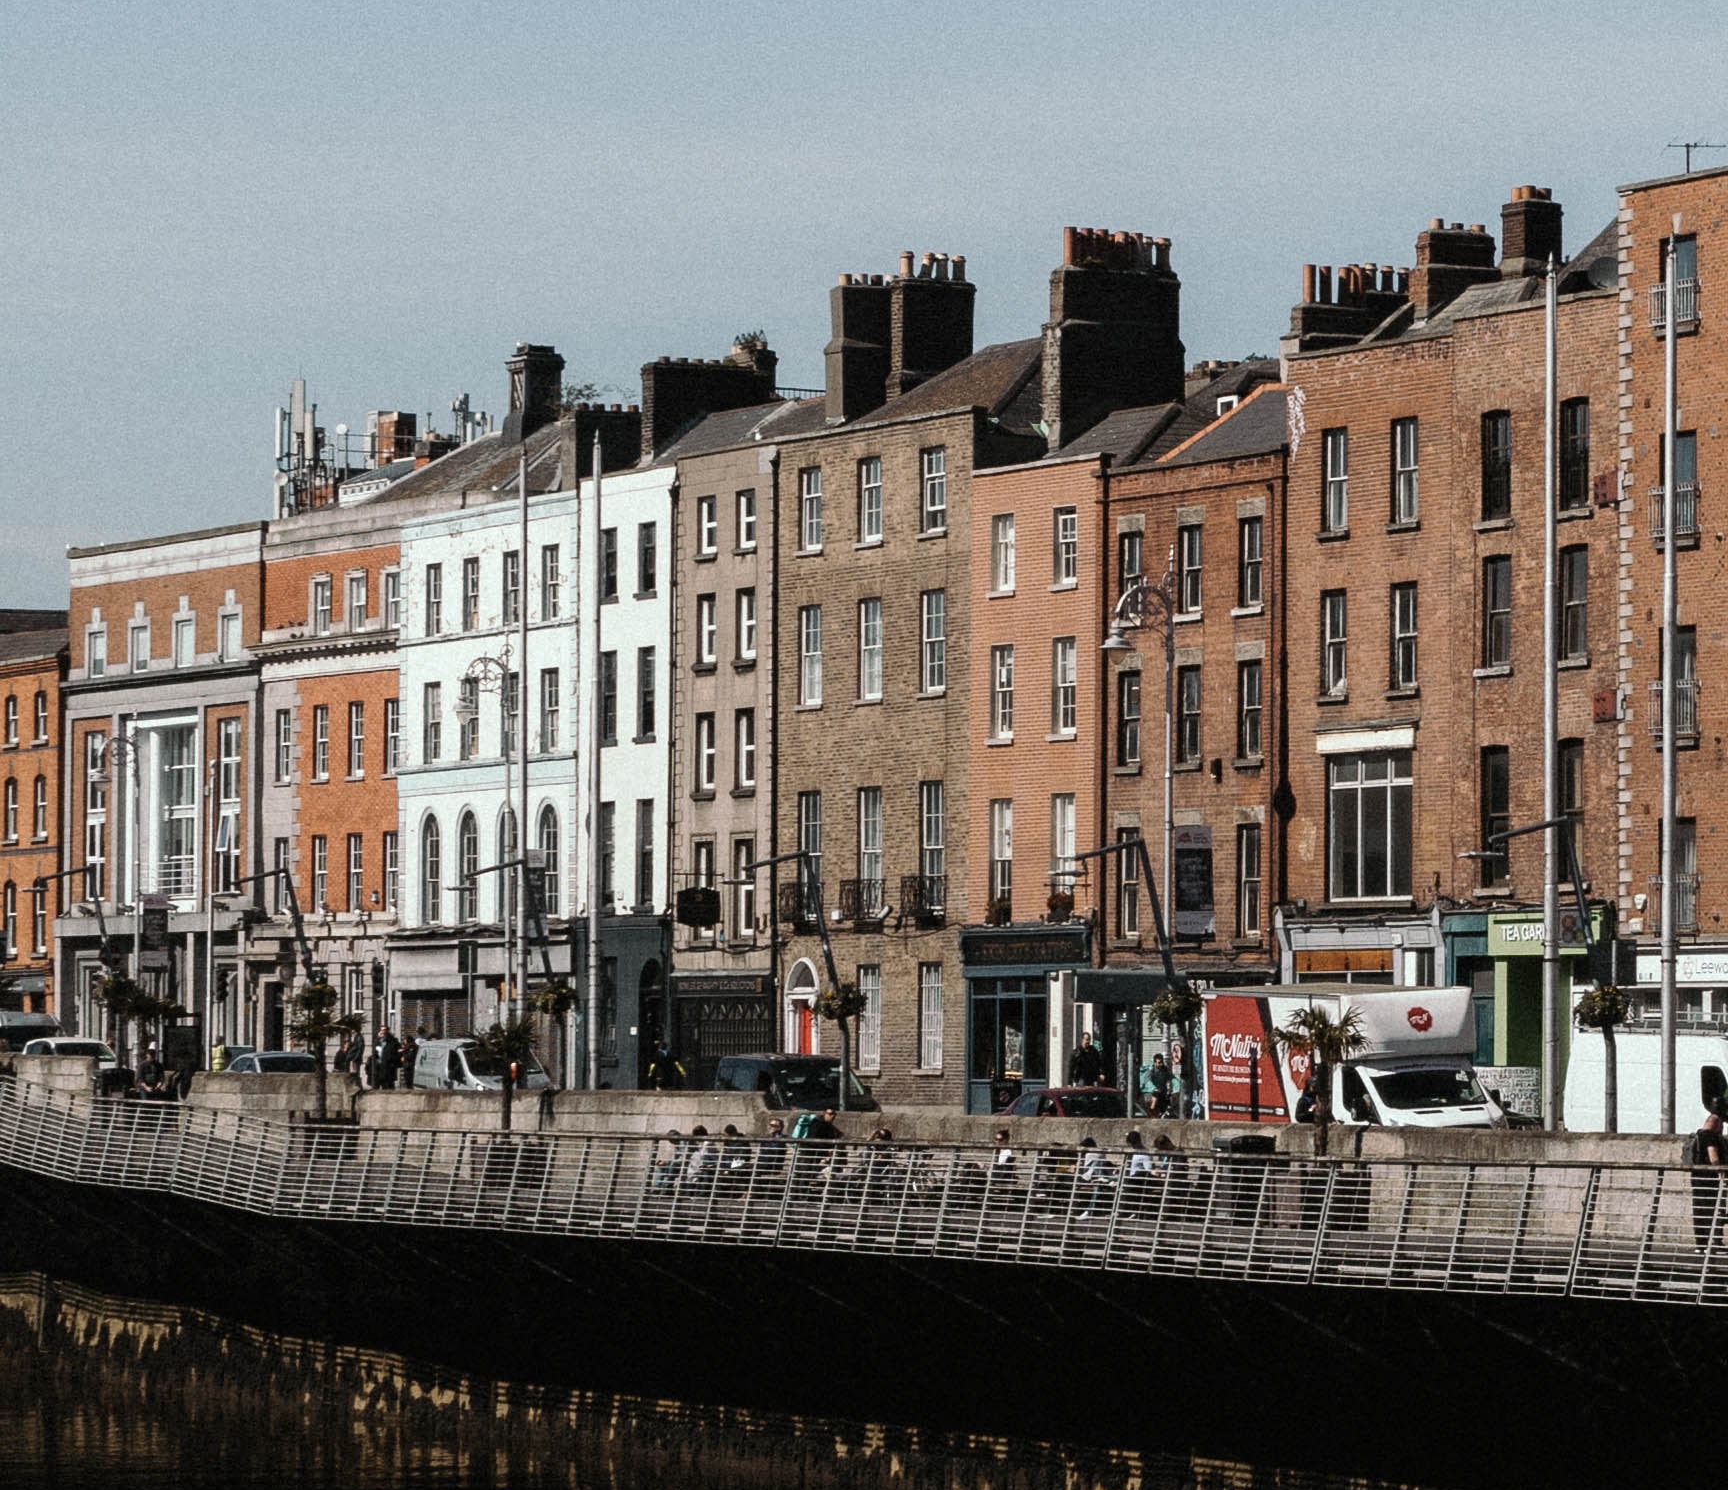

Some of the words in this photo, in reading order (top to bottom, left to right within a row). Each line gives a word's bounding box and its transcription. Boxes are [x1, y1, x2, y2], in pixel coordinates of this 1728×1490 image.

[1501, 925, 1520, 942] TEA
[1522, 924, 1545, 941] GAR
[1503, 1092, 1534, 1100] HOUSE
